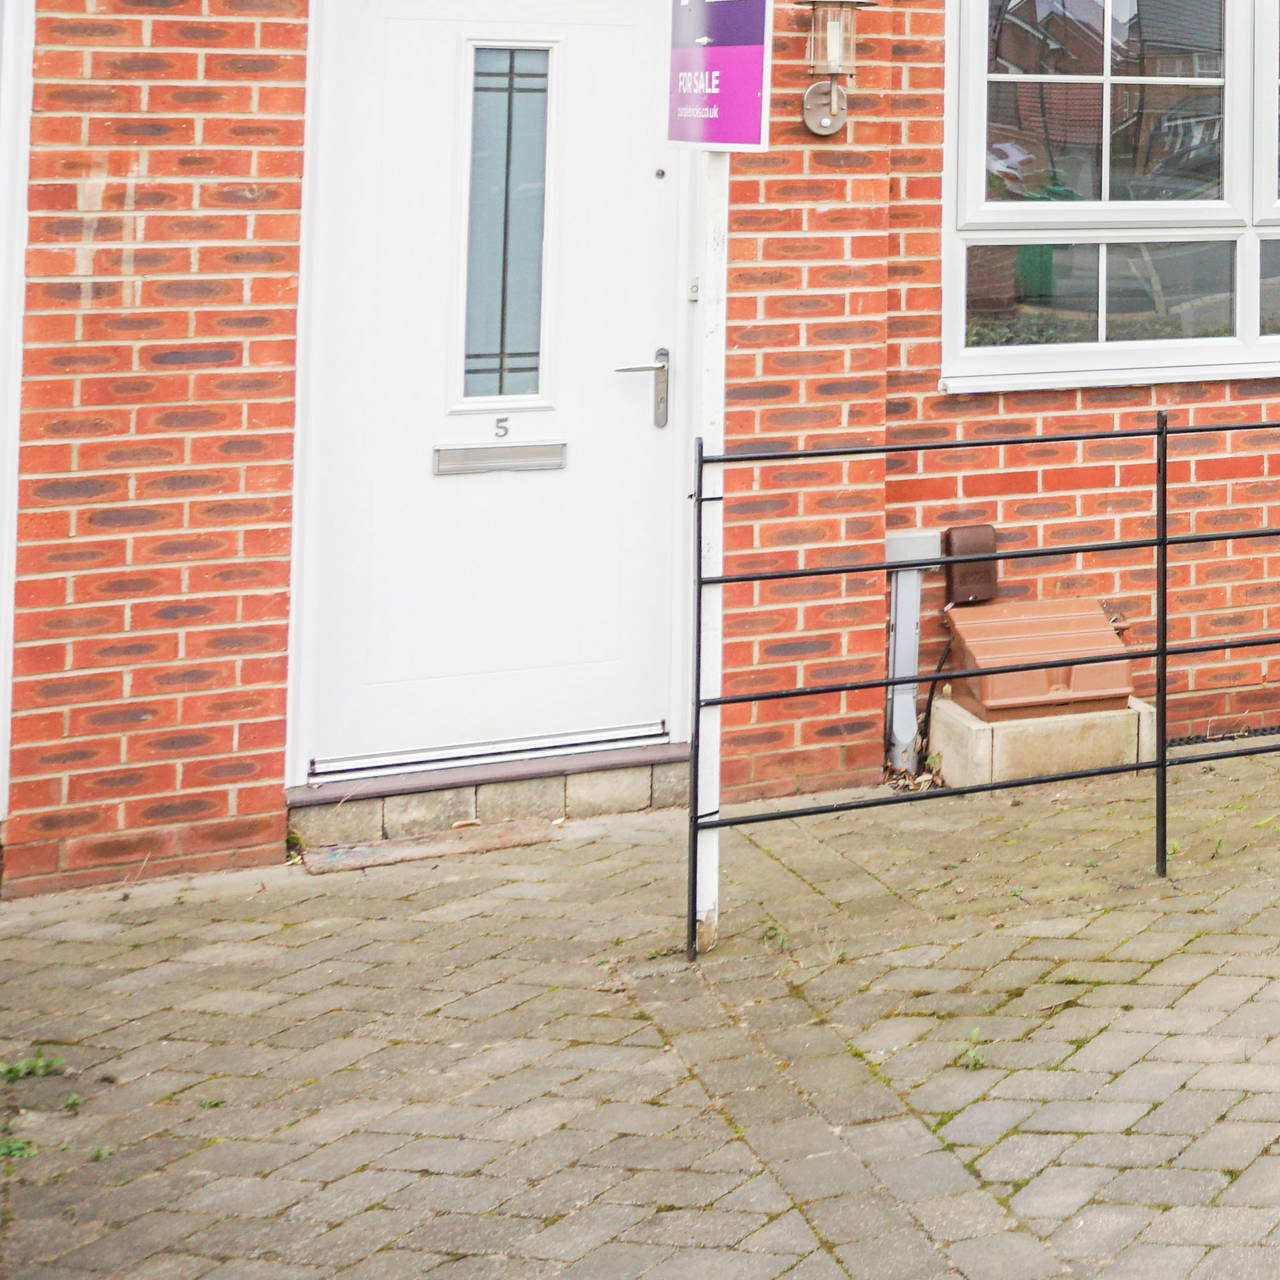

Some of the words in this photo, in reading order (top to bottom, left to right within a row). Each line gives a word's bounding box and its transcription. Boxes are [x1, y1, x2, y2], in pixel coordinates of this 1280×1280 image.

[678, 71, 692, 94] FOR
[693, 70, 721, 94] SALE
[495, 417, 509, 438] 5
